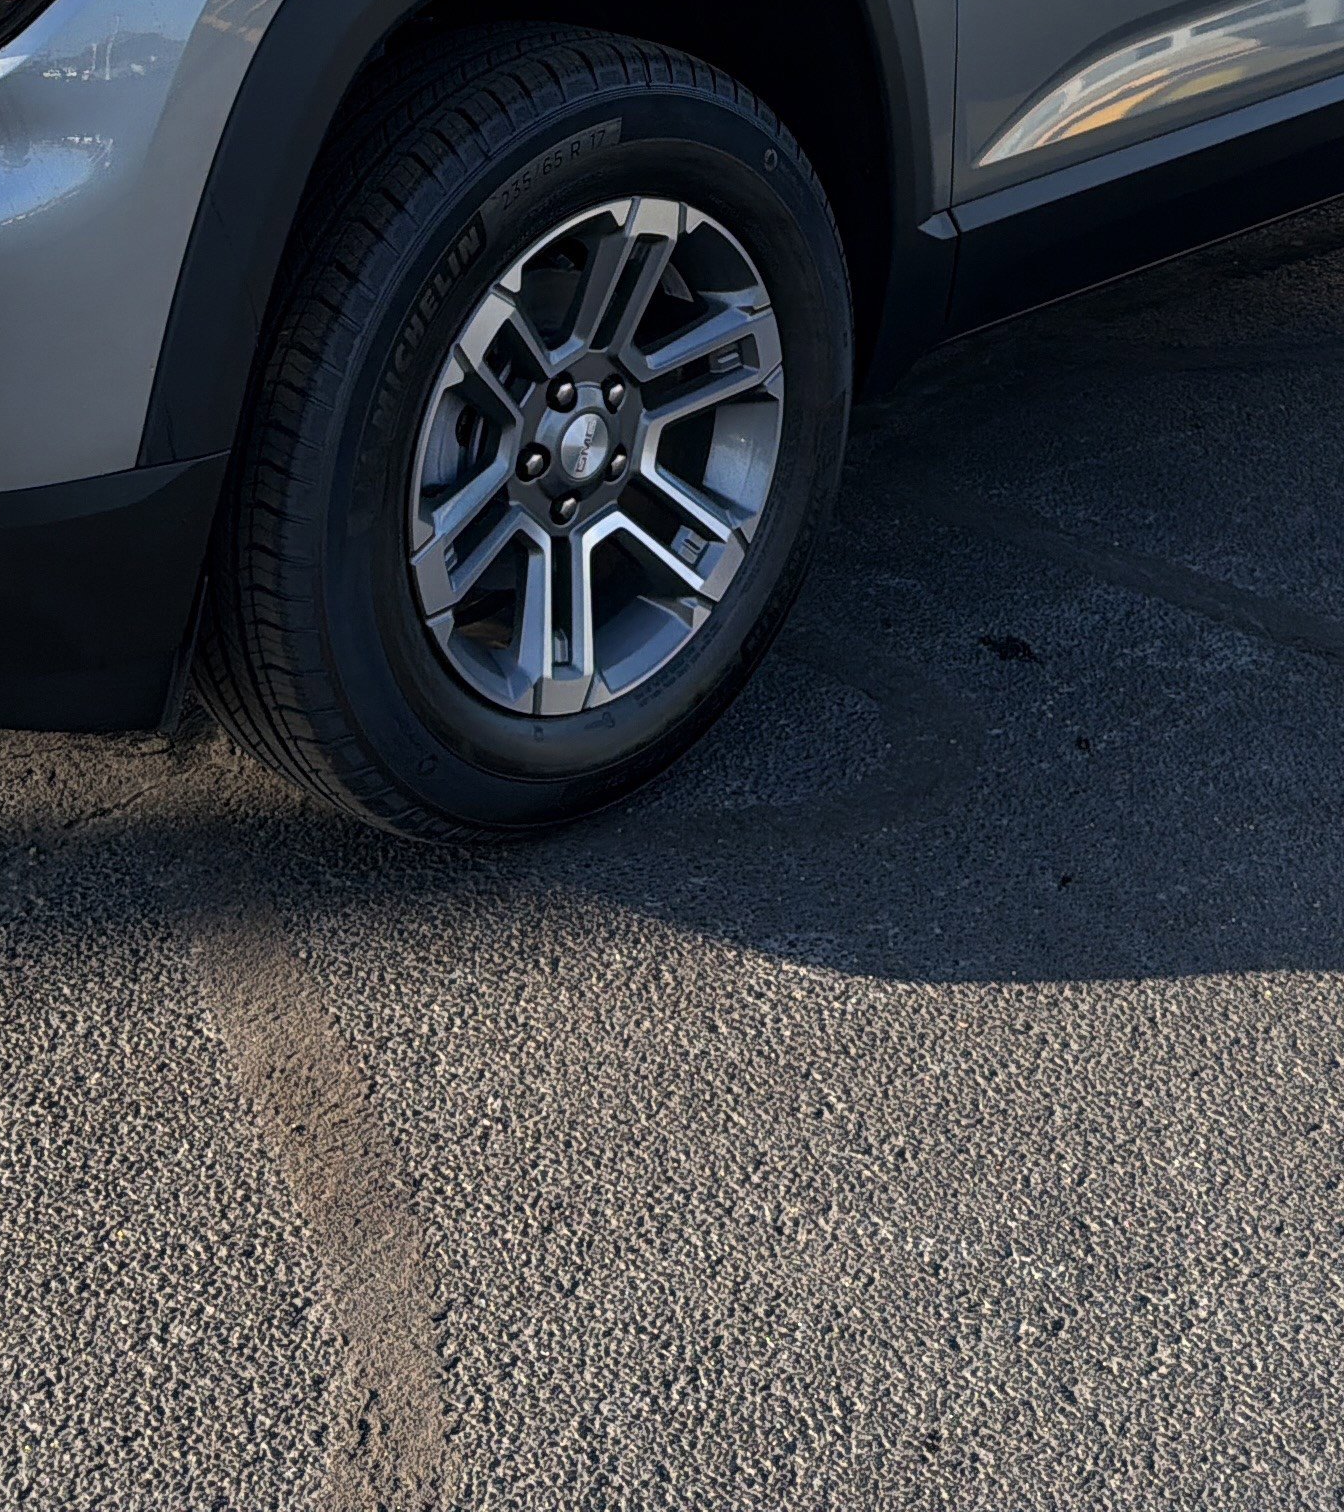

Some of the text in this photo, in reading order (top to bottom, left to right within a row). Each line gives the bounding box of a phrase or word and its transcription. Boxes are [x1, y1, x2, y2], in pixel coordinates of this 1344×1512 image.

[501, 130, 606, 210] 235/65 R 17
[371, 223, 484, 430] MICHELIN
